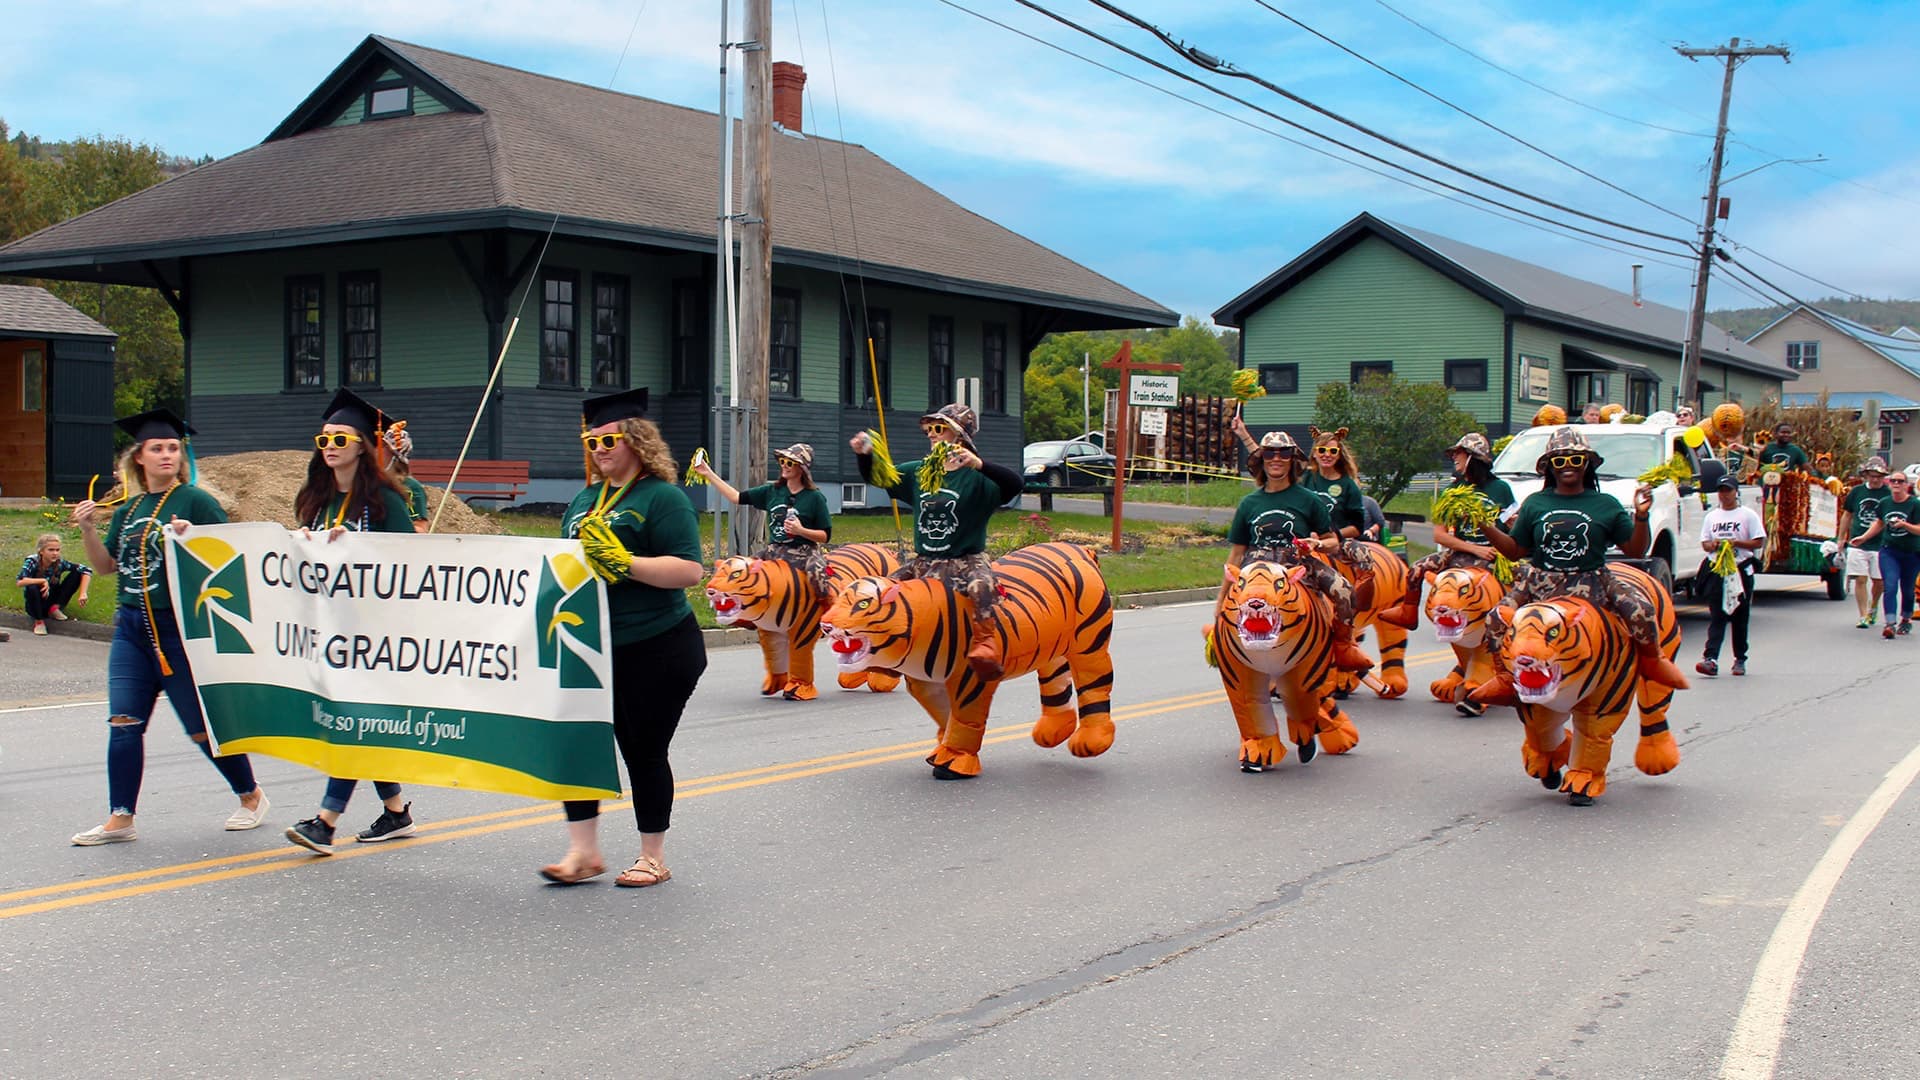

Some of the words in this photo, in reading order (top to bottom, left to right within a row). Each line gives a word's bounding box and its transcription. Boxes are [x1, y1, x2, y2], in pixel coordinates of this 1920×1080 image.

[1142, 380, 1168, 388] Historic
[1133, 391, 1149, 401] Train
[1151, 391, 1174, 402] Station
[1712, 522, 1741, 533] UMFK
[262, 551, 530, 608] COGRATULATIONS
[275, 621, 321, 665] UMF
[324, 634, 518, 682] GRADUATES!
[336, 715, 354, 732] so
[357, 709, 412, 741] proud
[414, 711, 436, 745] of
[431, 716, 466, 746] you!
